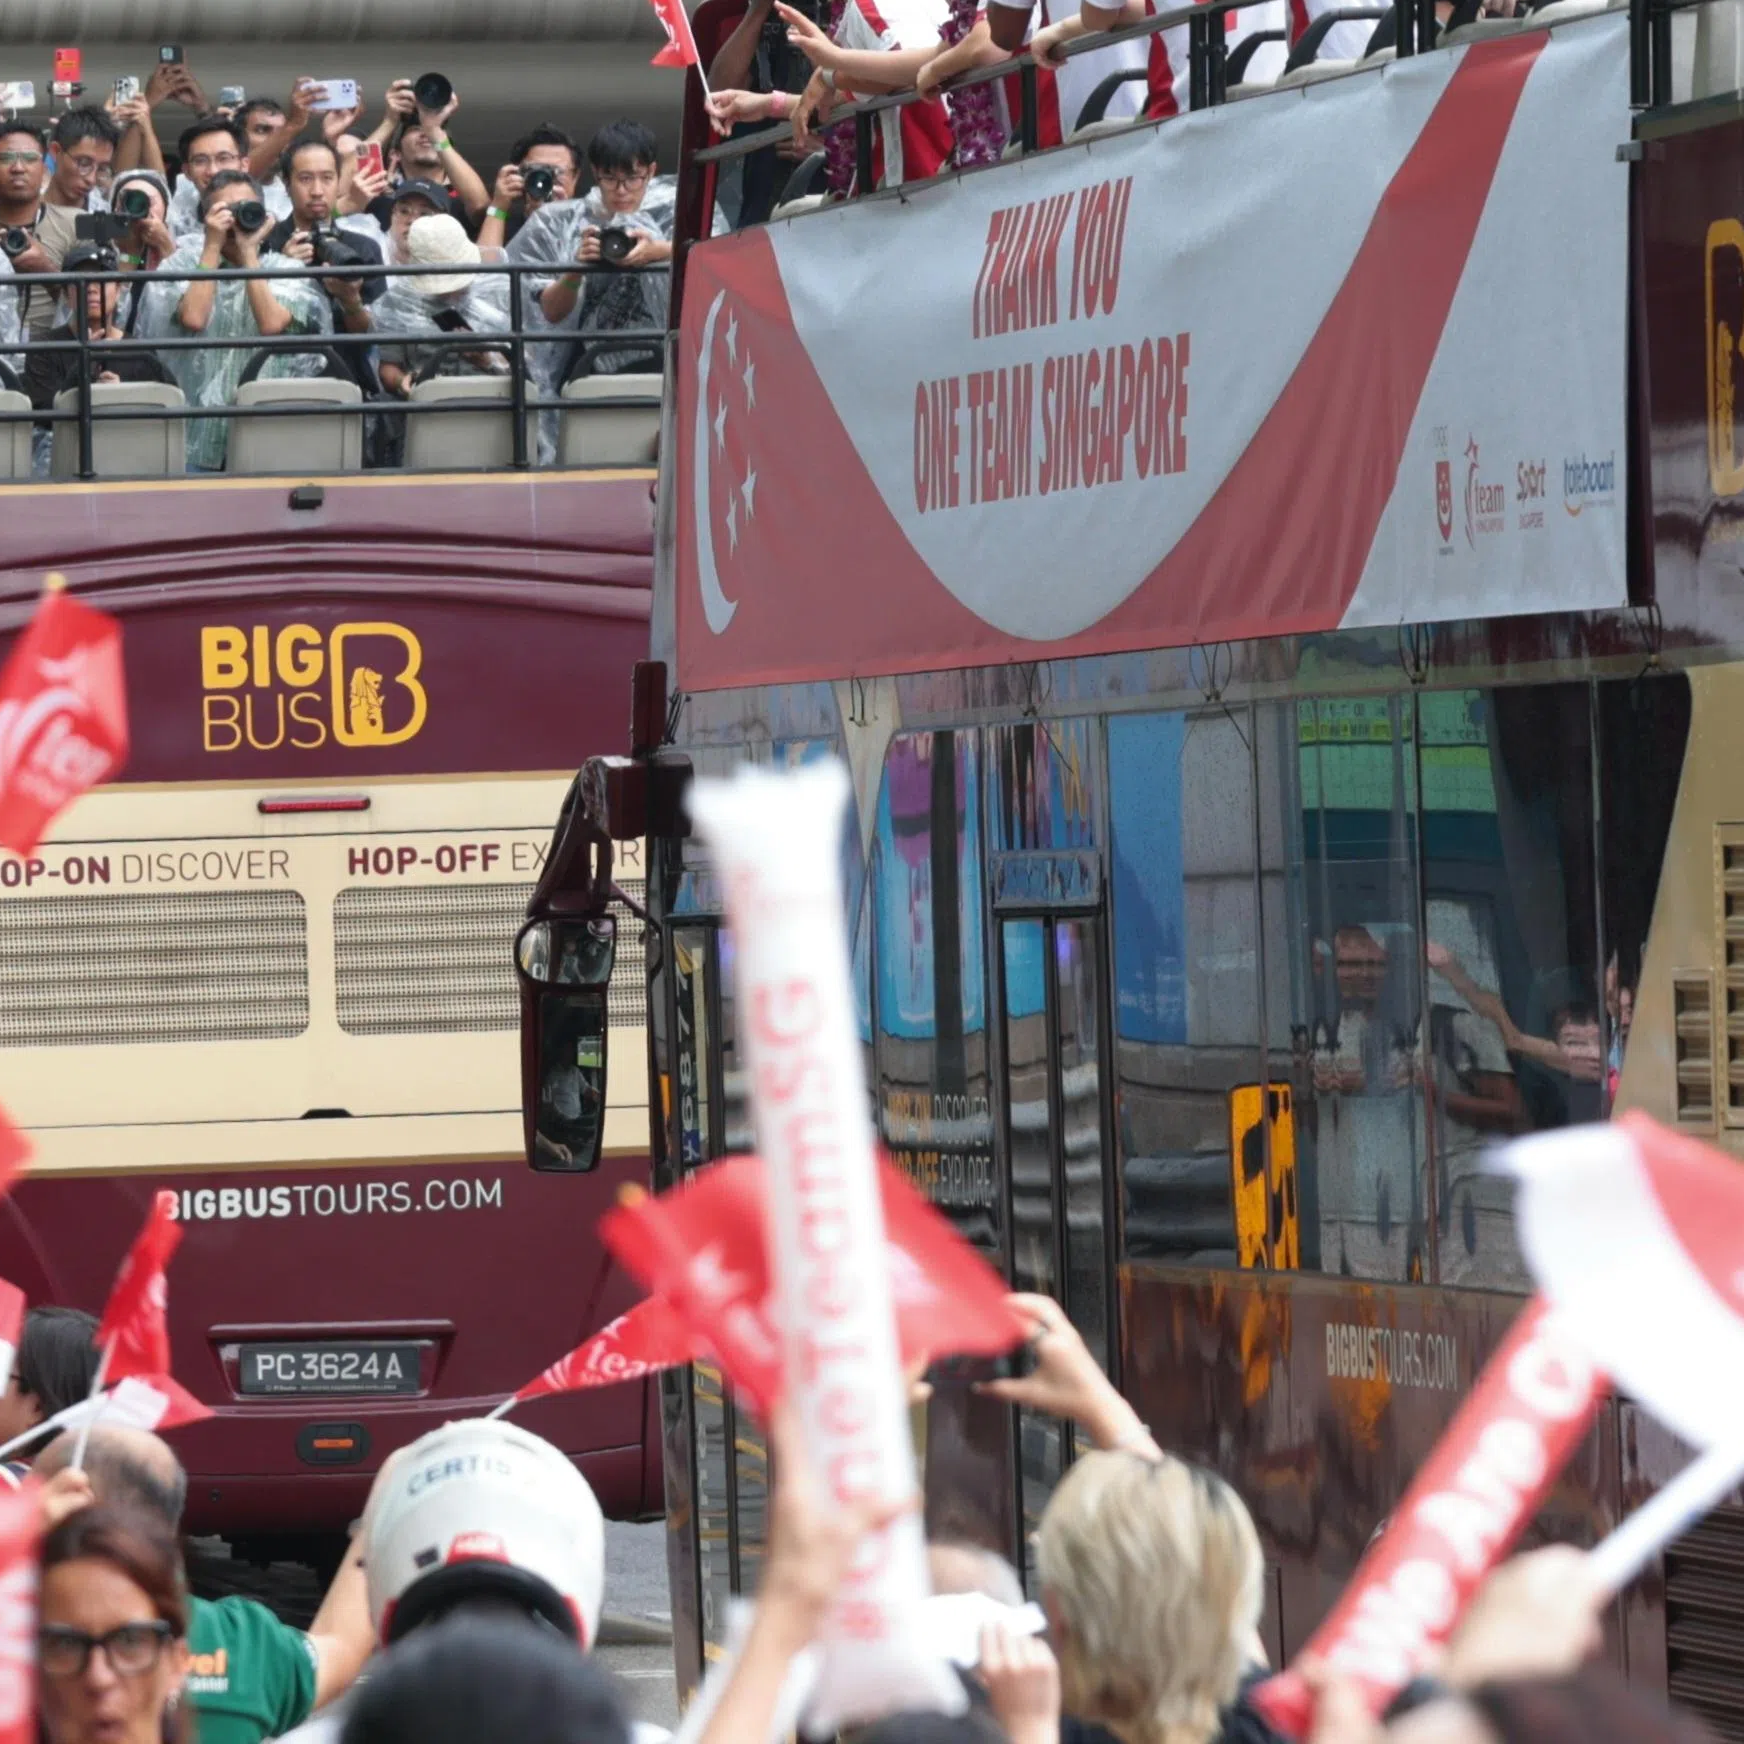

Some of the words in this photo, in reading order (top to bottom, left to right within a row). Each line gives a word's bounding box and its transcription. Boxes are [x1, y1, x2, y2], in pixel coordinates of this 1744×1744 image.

[973, 191, 1075, 339] THANK
[1070, 176, 1133, 320] YOU
[914, 376, 960, 515] ONE
[967, 362, 1033, 505] TEAM
[1038, 332, 1191, 496] SINGAPORE
[201, 624, 324, 689] BIG
[203, 693, 327, 752] BUS
[122, 849, 290, 887] DISCOVER
[347, 843, 501, 877] HOP-OFF
[157, 1178, 503, 1222] BIGBUSTOURS.COM
[940, 1153, 992, 1208] EXPLORE
[256, 1352, 403, 1381] PC3624A
[1325, 1322, 1457, 1392] BIGBUSTOURS.COM
[407, 1454, 513, 1496] CERTIS
